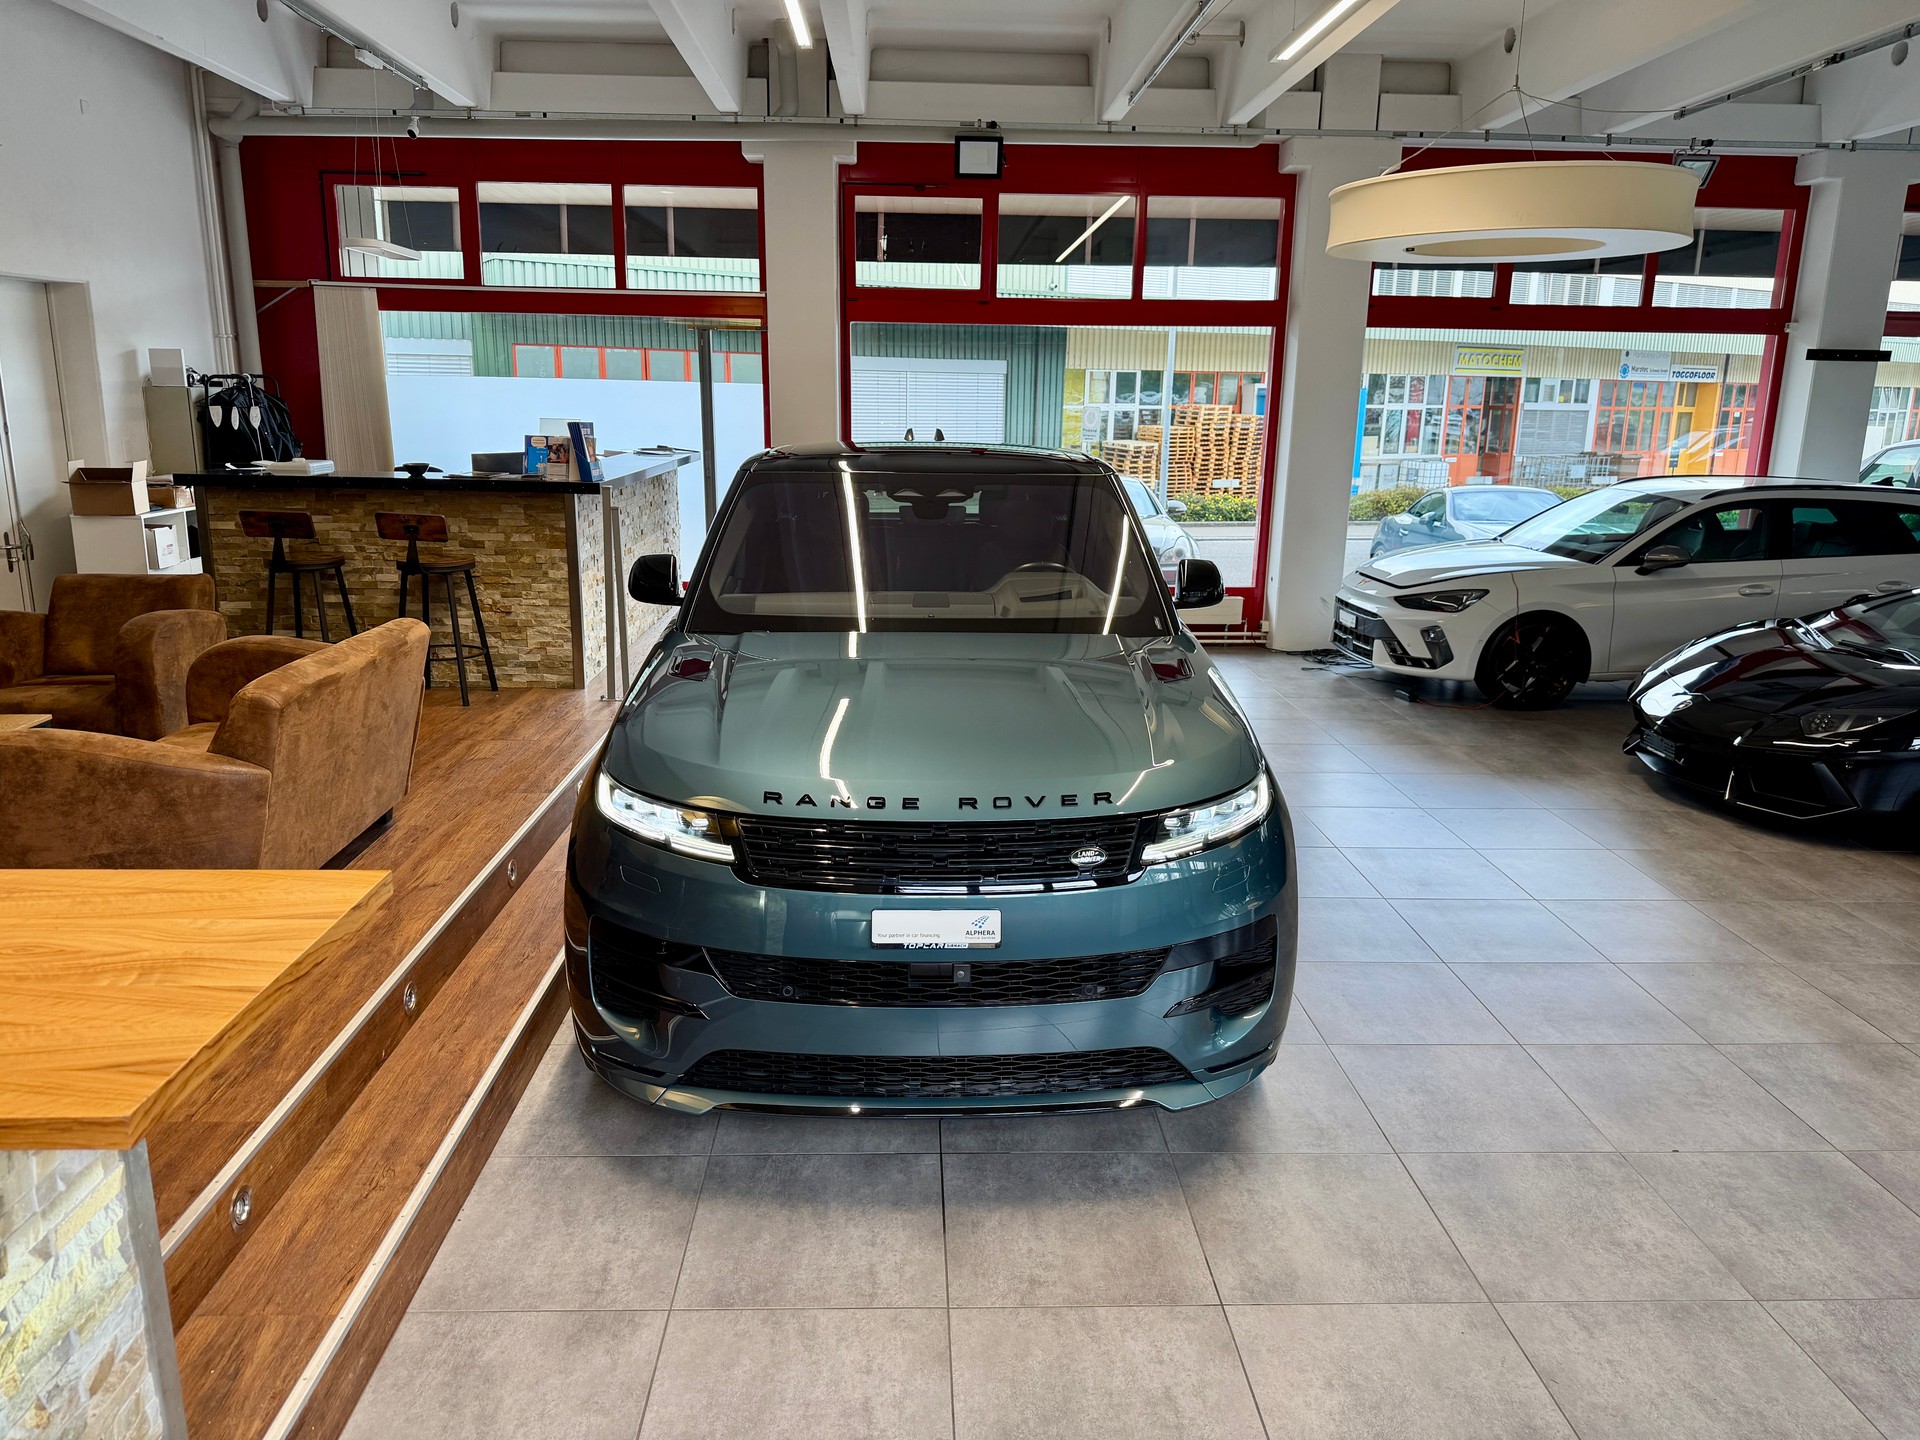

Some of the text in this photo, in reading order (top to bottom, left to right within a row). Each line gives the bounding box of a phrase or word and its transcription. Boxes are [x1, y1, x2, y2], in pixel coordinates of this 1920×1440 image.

[1458, 353, 1523, 368] MATOCHEM
[1671, 370, 1716, 380] TOGGOFLOOR
[763, 790, 1114, 810] RANGE ROVER
[1077, 850, 1095, 858] LAND
